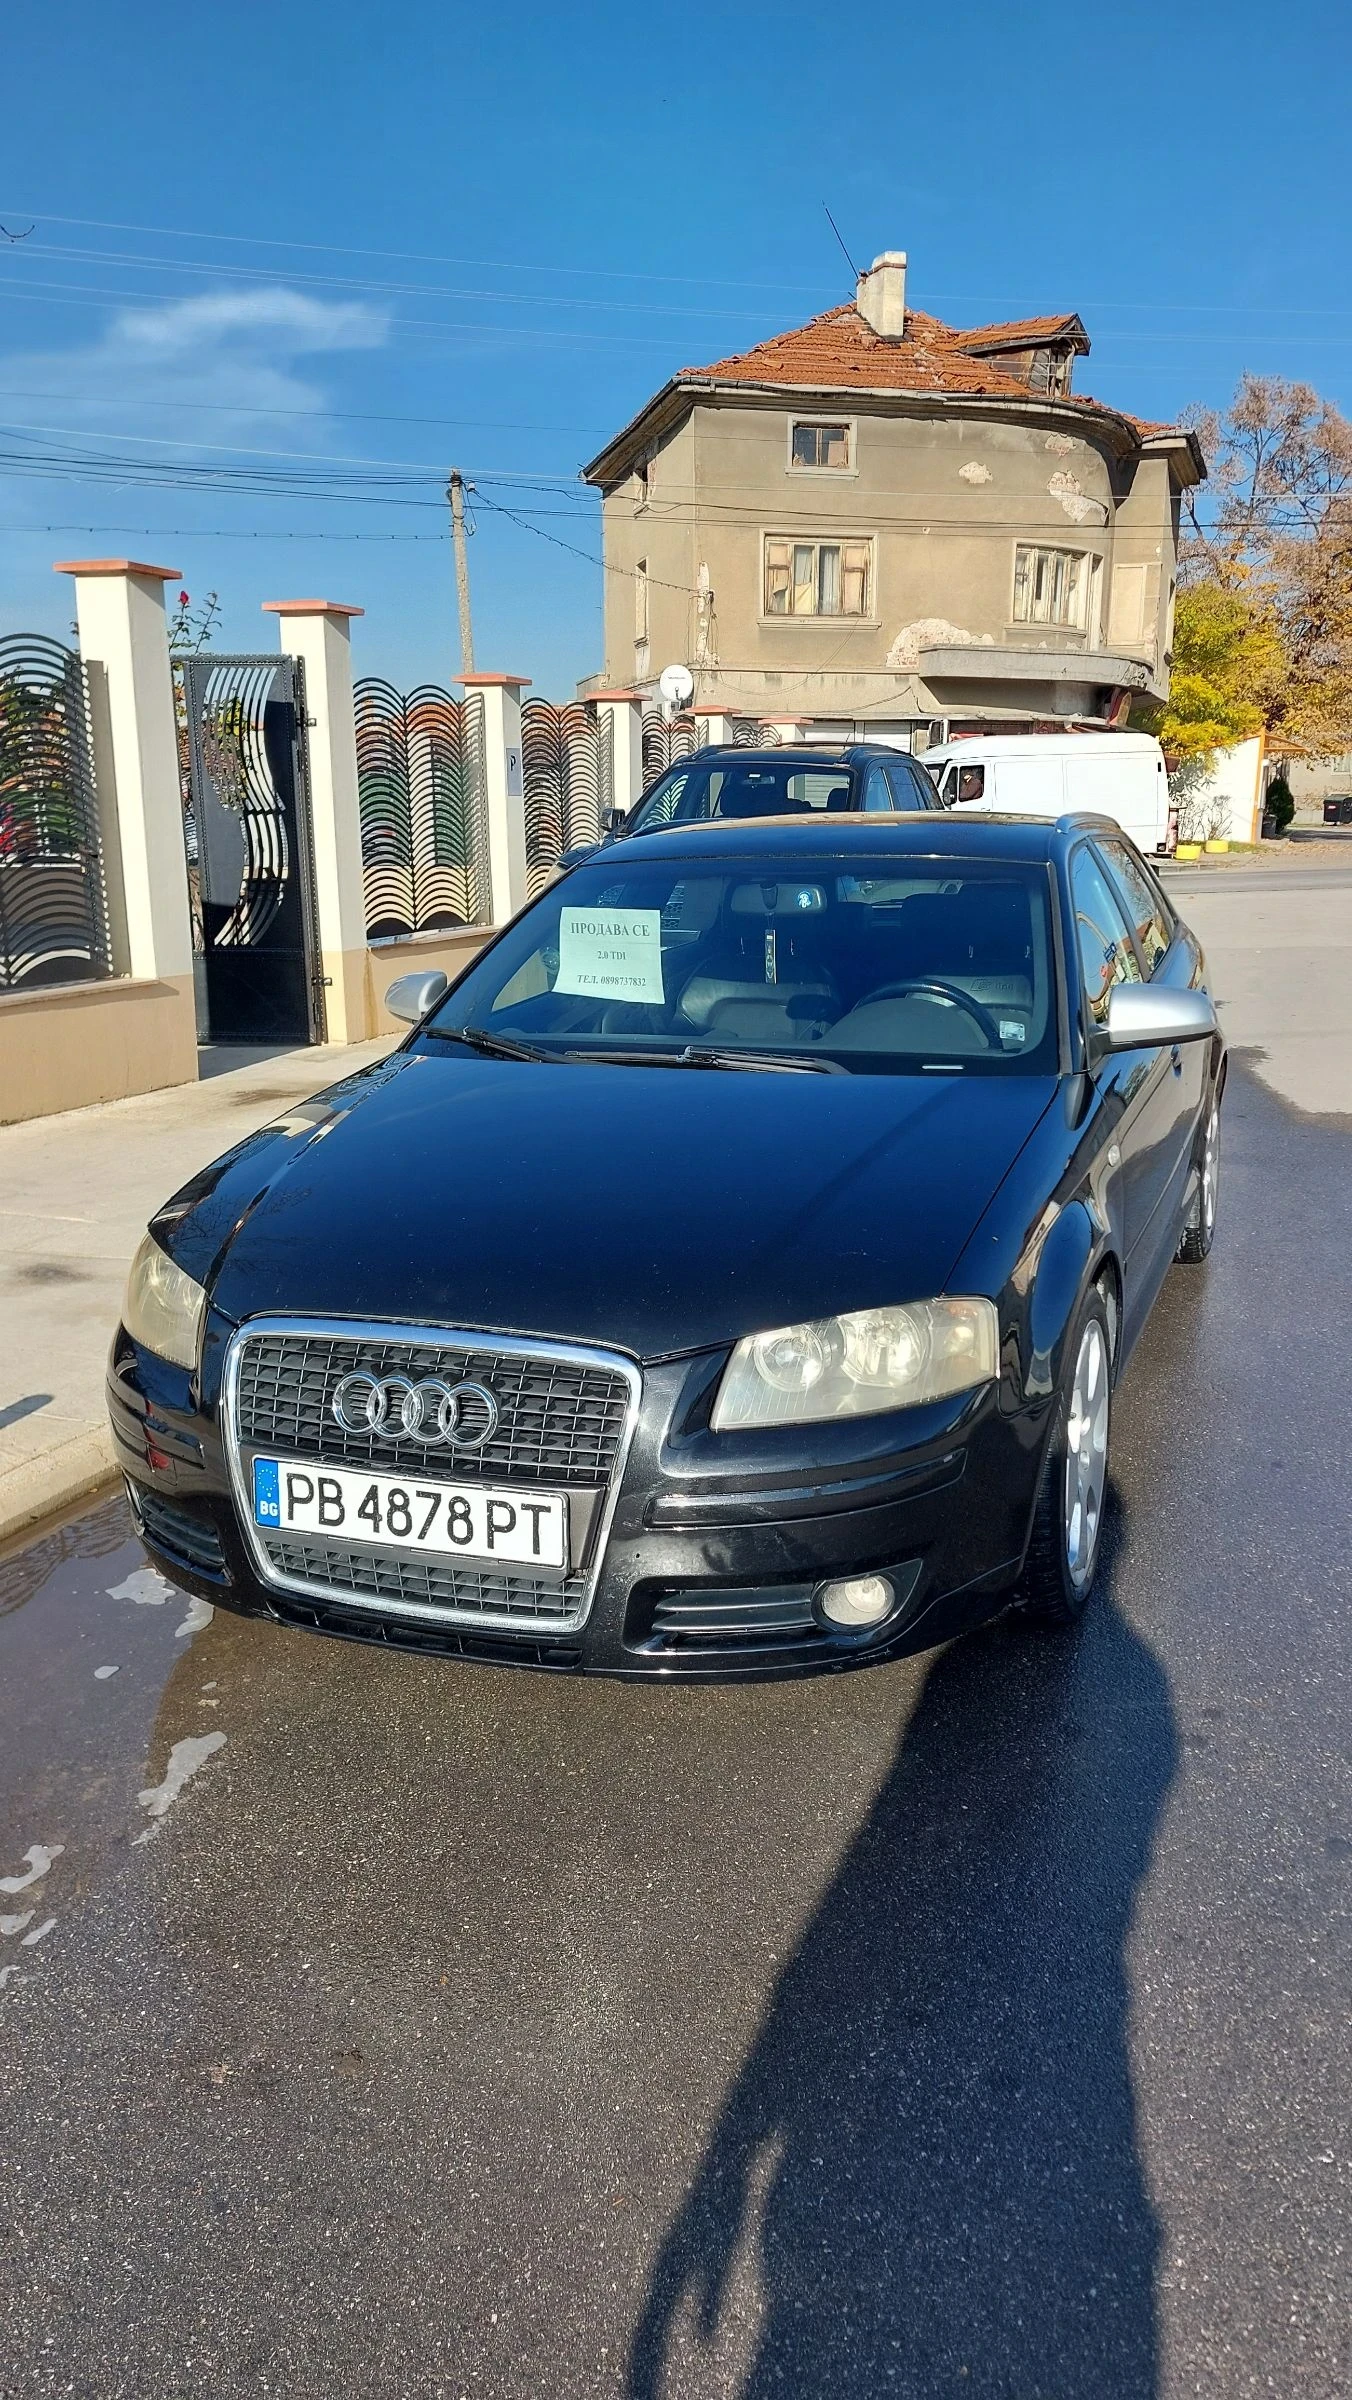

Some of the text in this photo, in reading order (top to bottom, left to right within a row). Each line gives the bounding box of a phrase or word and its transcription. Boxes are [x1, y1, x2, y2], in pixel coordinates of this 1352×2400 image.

[571, 922, 650, 937] ПРОДАВА СЕ
[598, 951, 626, 961] 2.0 TDI
[577, 975, 598, 984] ТЕЛ.
[259, 1501, 278, 1517] BG
[286, 1472, 552, 1555] PB 4878 PT
